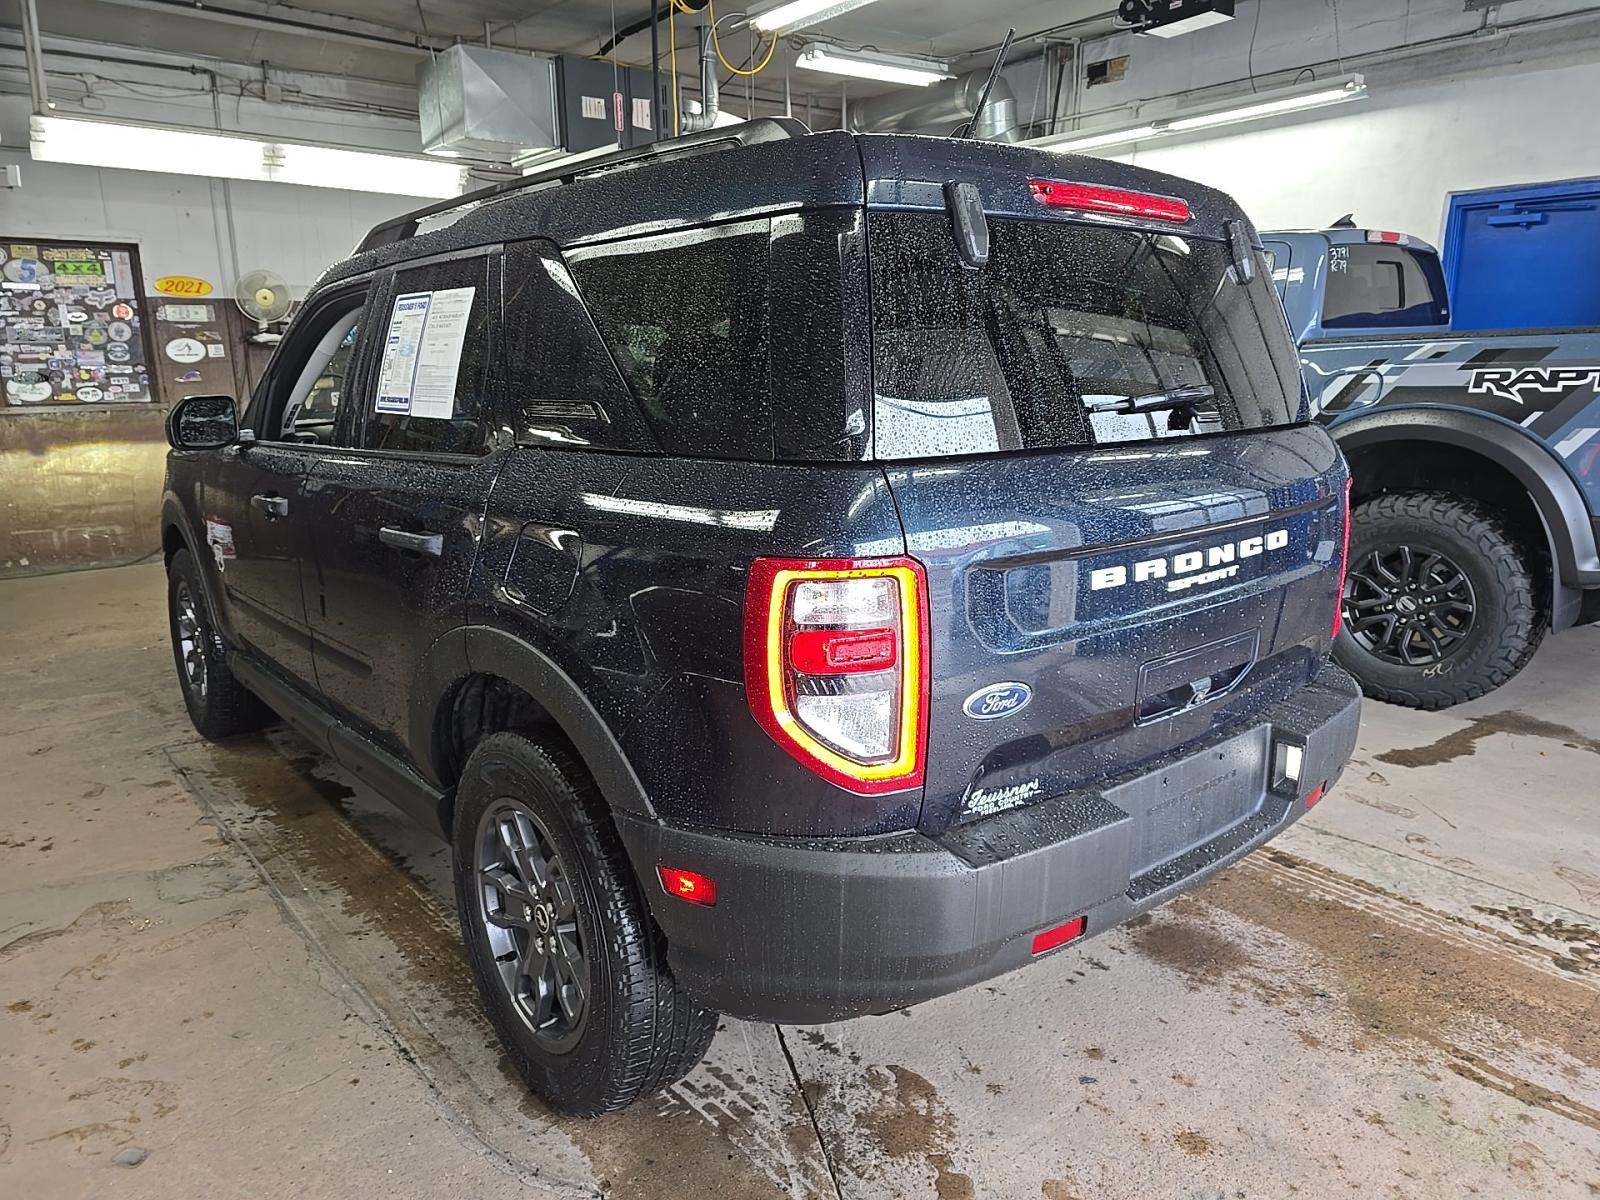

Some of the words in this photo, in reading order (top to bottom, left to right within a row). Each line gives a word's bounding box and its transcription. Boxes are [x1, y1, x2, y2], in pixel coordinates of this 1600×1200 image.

[164, 279, 204, 294] 2021
[1091, 529, 1289, 591] BRONCO
[1166, 564, 1240, 592] SPORT
[981, 691, 1019, 714] Ford
